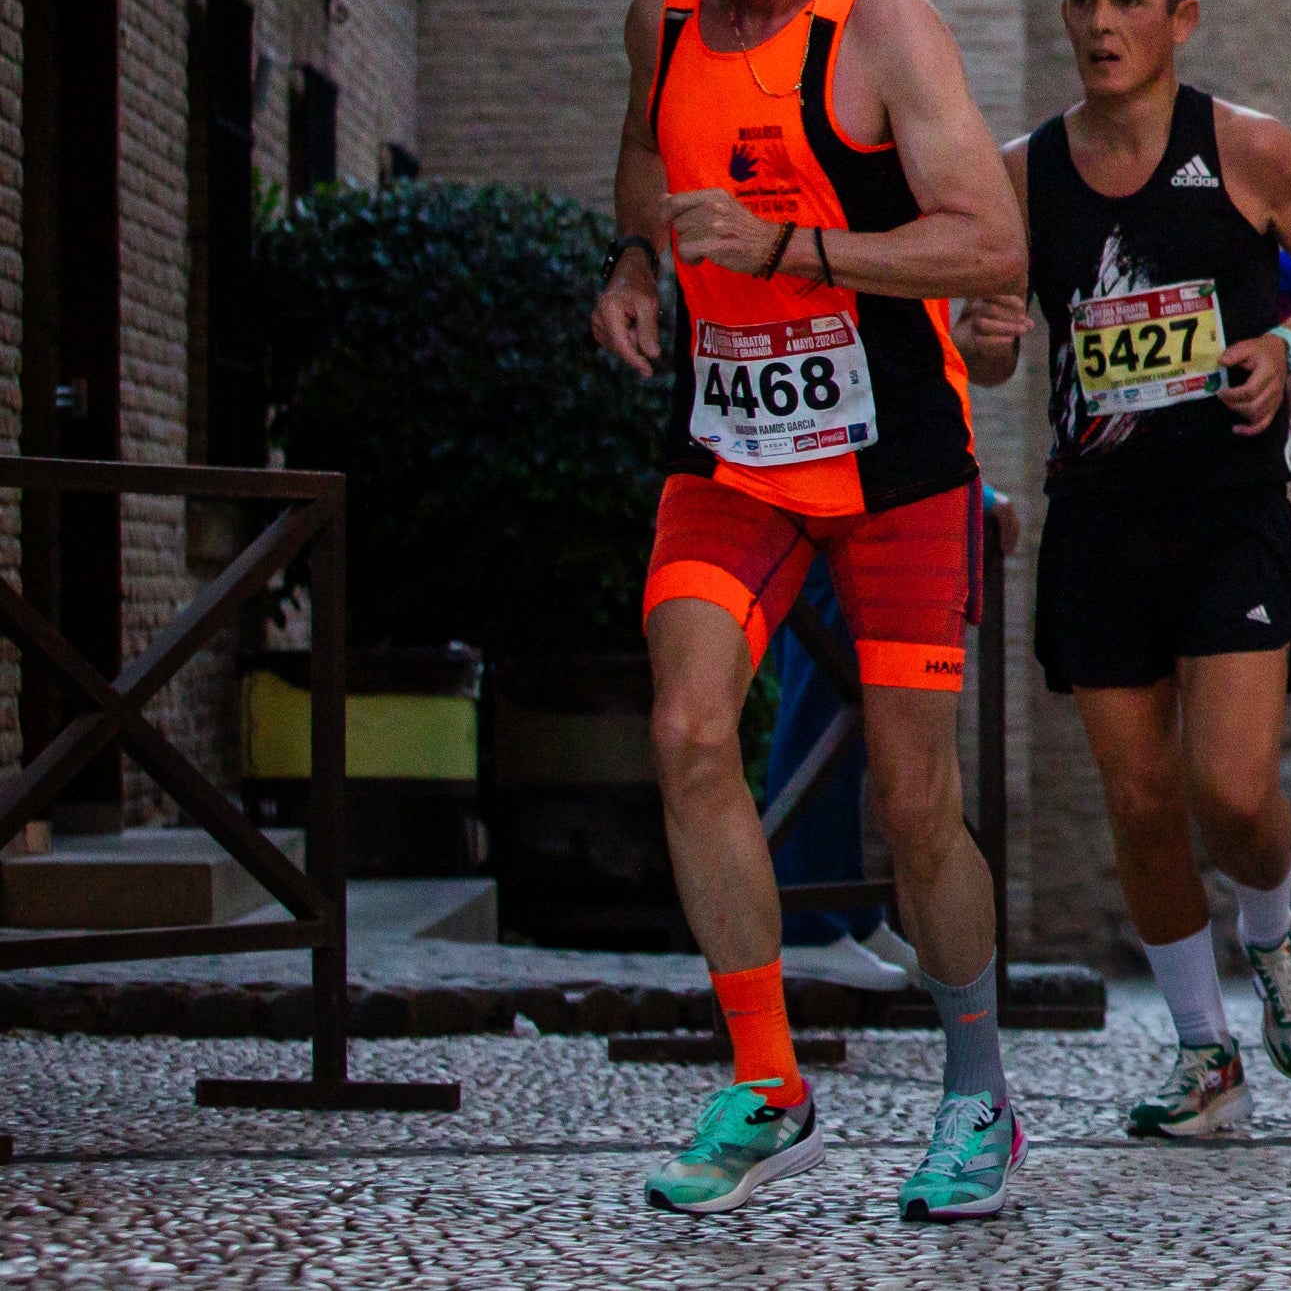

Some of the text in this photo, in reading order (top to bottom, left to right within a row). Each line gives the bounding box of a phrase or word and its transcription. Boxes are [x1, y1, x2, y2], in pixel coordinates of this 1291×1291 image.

[1171, 174, 1219, 188] adidas
[786, 333, 836, 353] 4 MAYO 2024
[1082, 317, 1199, 378] 5427
[703, 355, 841, 419] 4468
[759, 420, 786, 434] RAMOS
[787, 418, 816, 431] GARCIA
